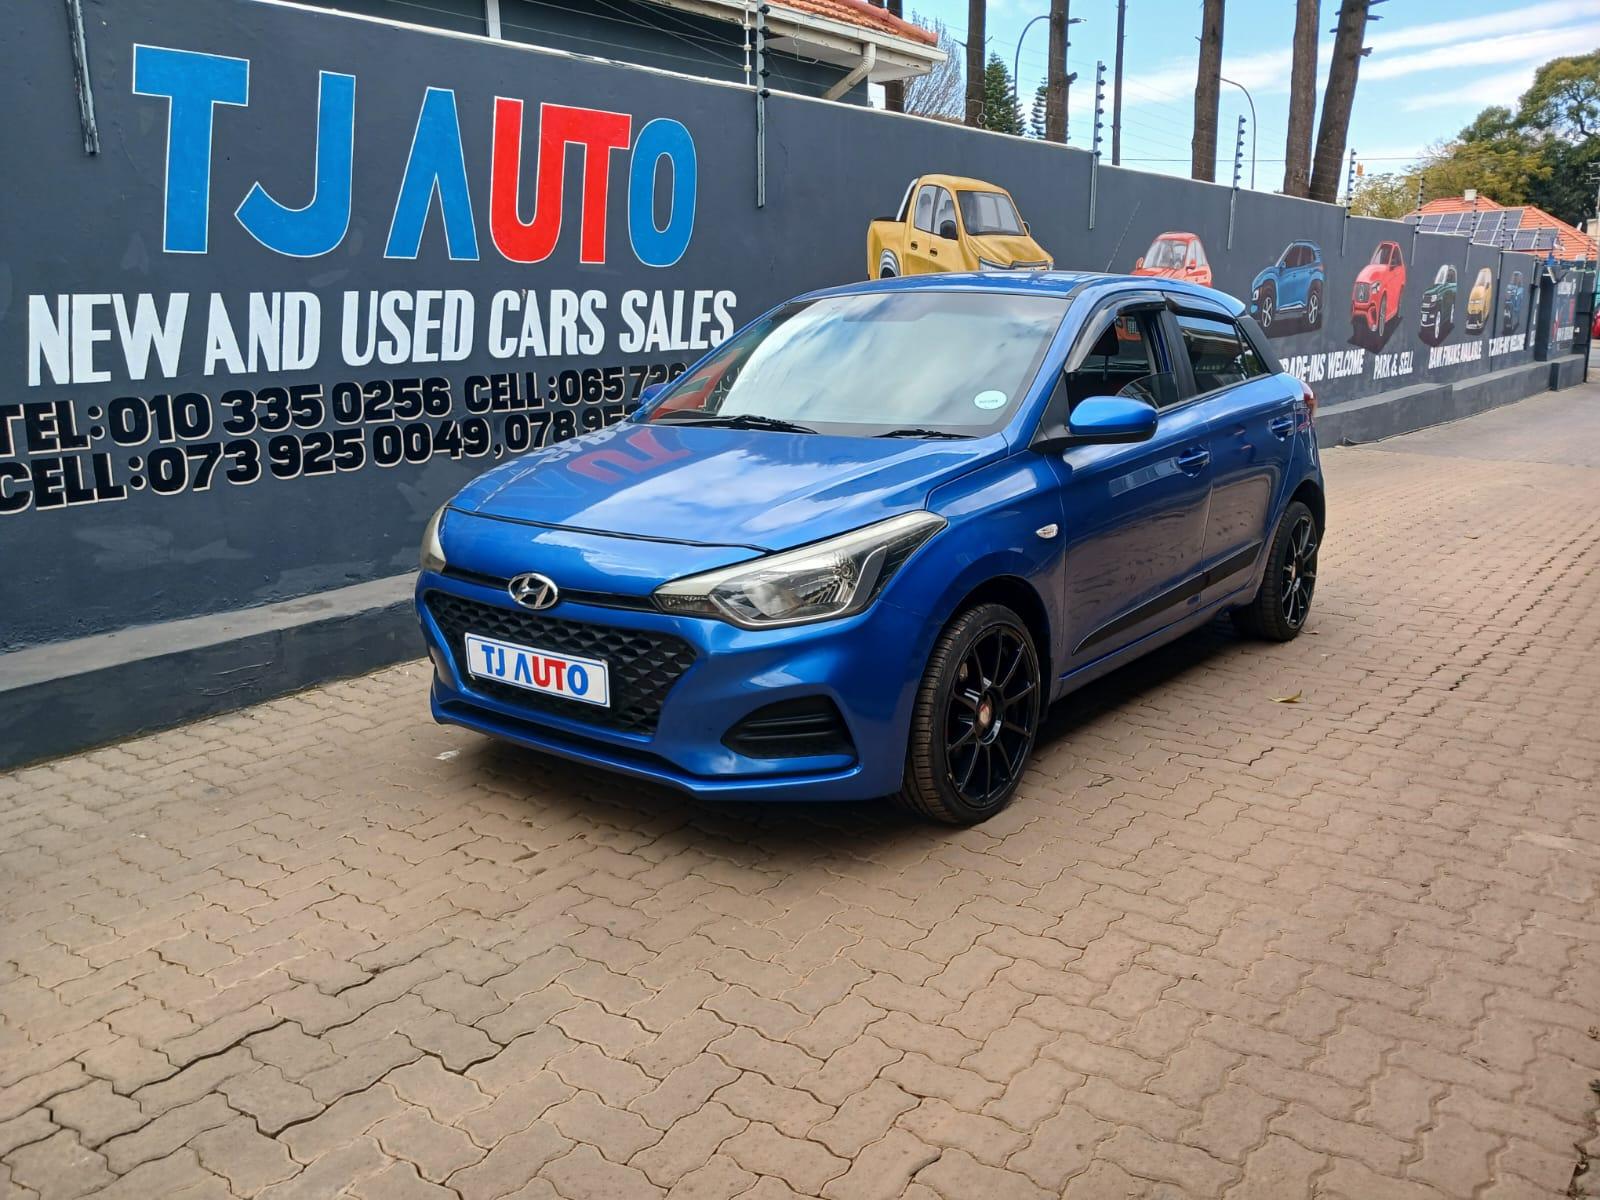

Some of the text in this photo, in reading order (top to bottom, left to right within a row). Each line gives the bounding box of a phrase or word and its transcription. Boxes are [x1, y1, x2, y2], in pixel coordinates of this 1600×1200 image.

[132, 43, 697, 267] TJ AUTO
[28, 289, 738, 386] NEW AND USED CARS SALES
[1279, 348, 1365, 382] RADE-INS WELCOME
[1373, 350, 1413, 380] PARK & SELL
[220, 383, 326, 436] 335
[331, 376, 452, 426] 0256
[268, 428, 367, 476] 925
[481, 644, 589, 695] TJ AUTO
